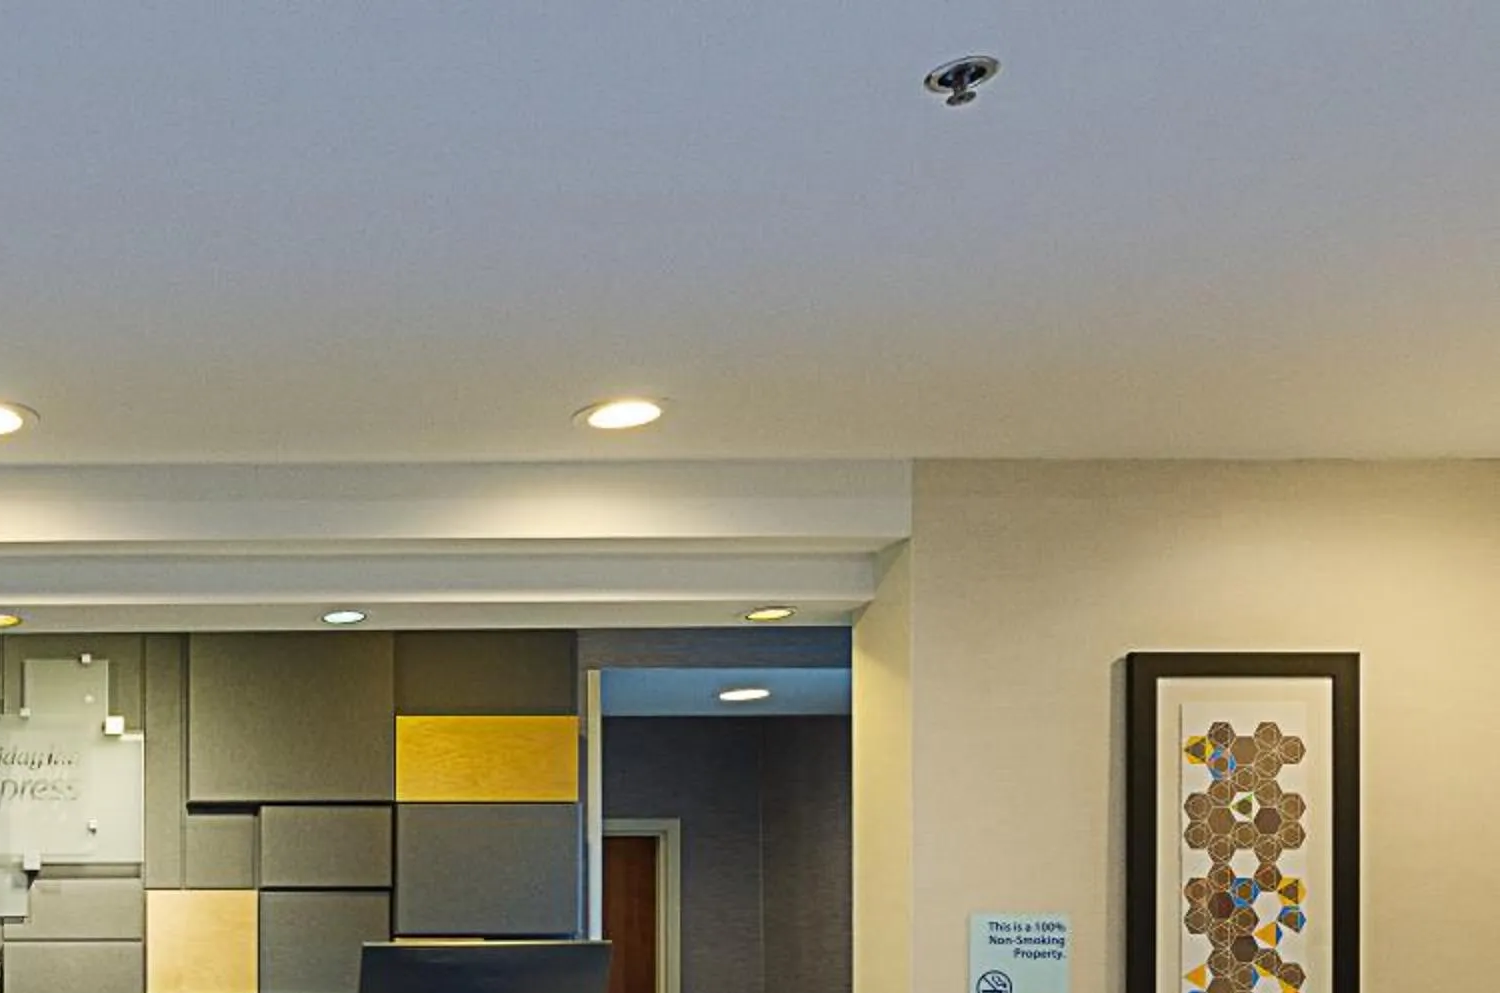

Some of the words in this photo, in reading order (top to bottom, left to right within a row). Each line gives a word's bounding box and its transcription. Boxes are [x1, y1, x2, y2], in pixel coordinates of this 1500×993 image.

[988, 921, 1011, 932] This
[1013, 921, 1022, 932] is
[1035, 921, 1067, 933] 100%
[988, 935, 1066, 948] Non-Smoking
[1013, 948, 1067, 960] Property.
